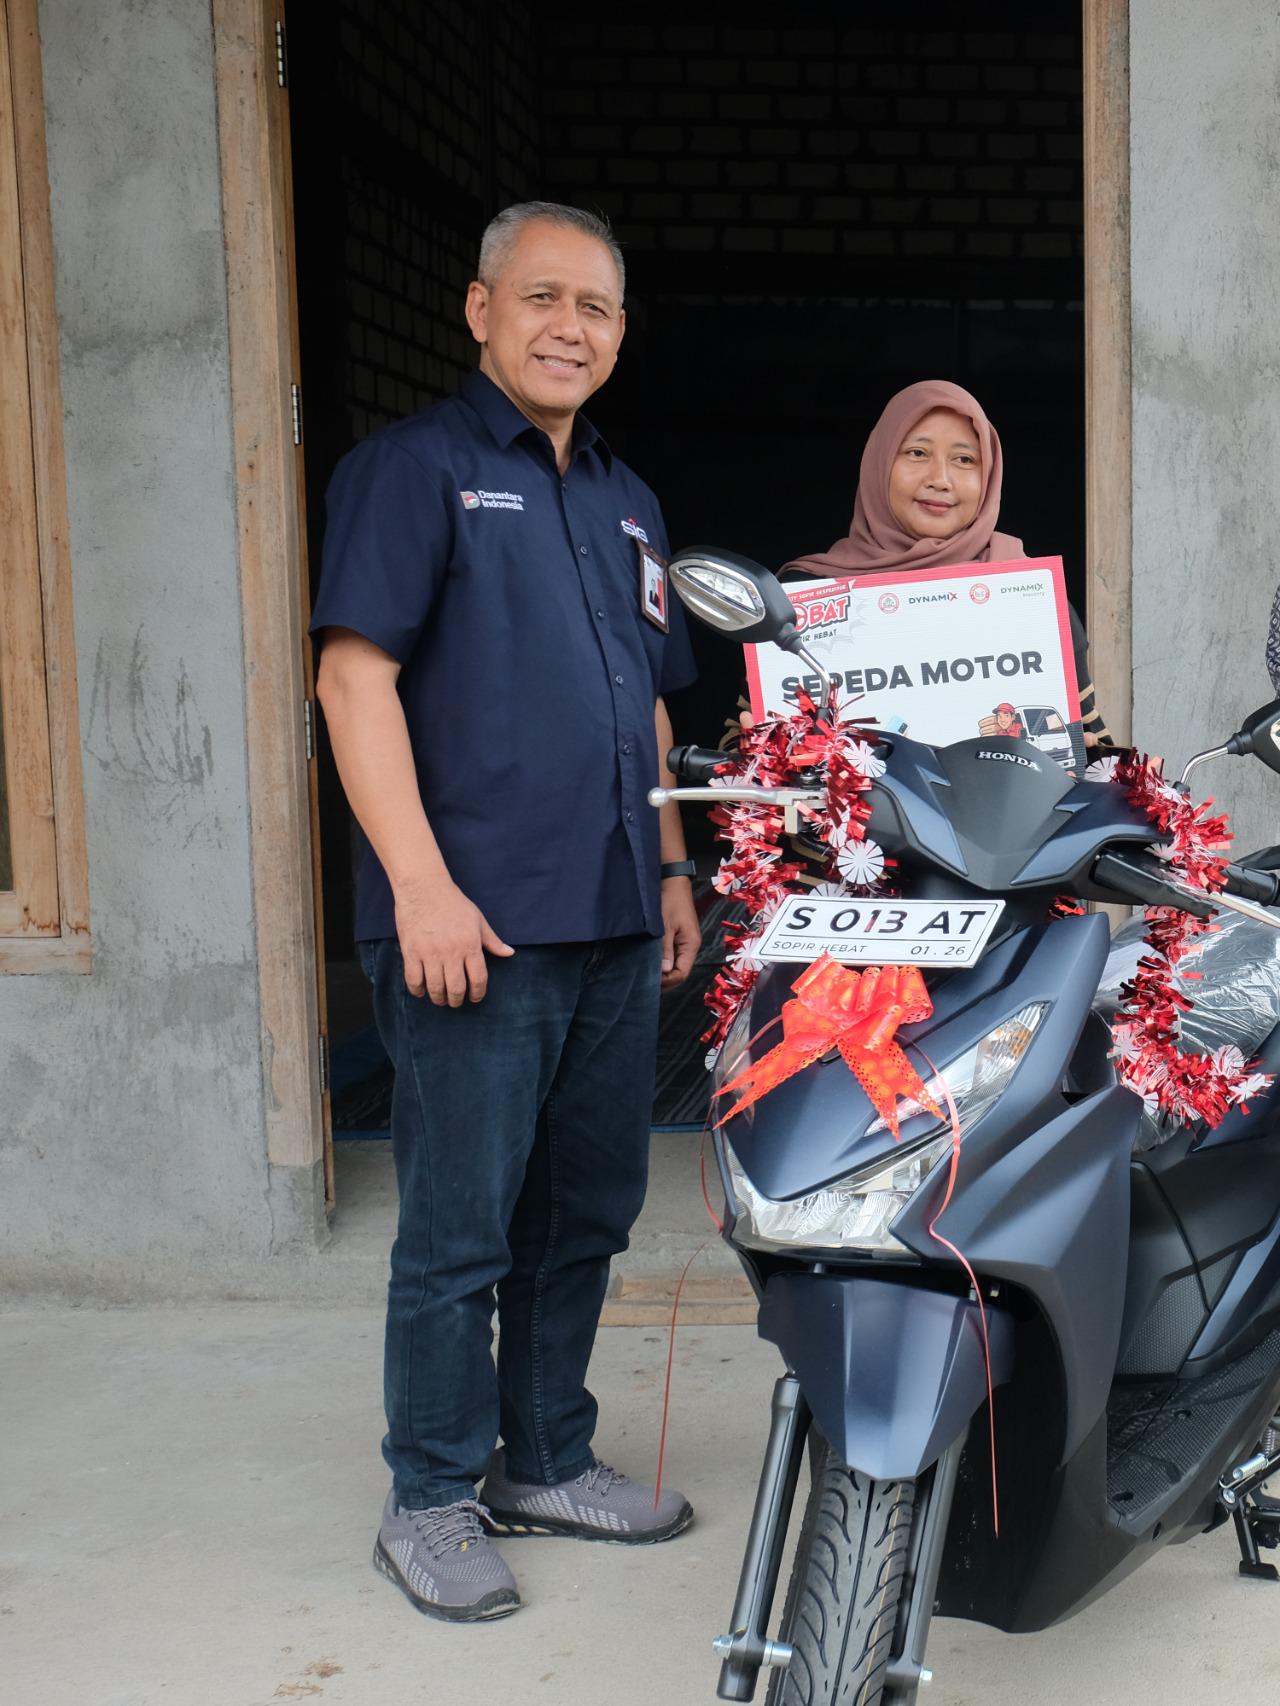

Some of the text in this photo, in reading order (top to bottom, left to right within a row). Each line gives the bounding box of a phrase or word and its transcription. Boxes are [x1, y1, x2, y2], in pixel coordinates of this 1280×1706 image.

[477, 490, 524, 502] Danantara
[480, 499, 524, 510] Indonesia
[621, 520, 648, 543] SIG
[1000, 582, 1044, 594] DYNAMIX
[908, 592, 958, 605] DYNAMIX
[781, 651, 1044, 701] SEPEDA MOTOR
[978, 751, 1042, 773] HONDA
[785, 906, 987, 935] S 013 AT
[771, 940, 816, 952] SOPIR
[819, 944, 868, 954] HEBAT
